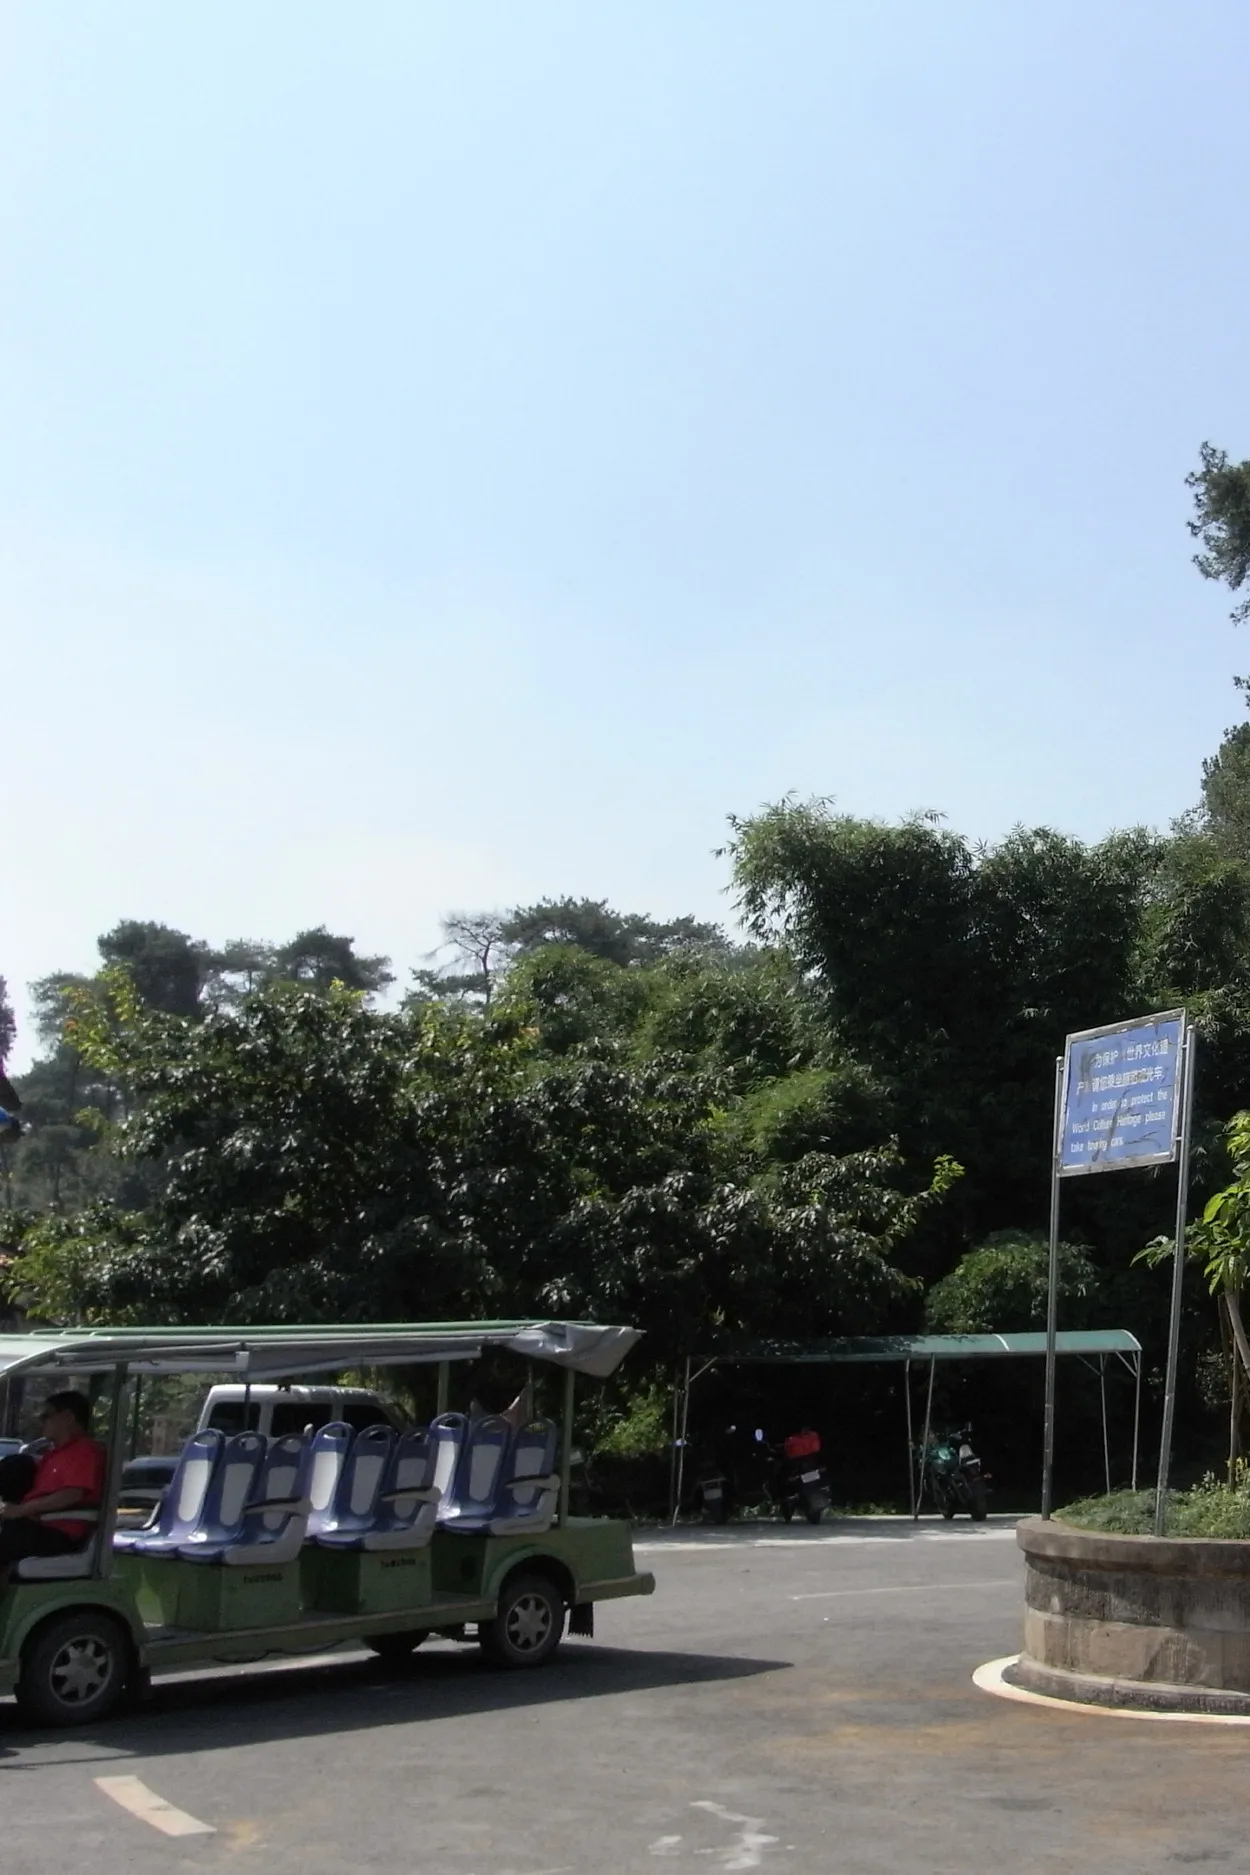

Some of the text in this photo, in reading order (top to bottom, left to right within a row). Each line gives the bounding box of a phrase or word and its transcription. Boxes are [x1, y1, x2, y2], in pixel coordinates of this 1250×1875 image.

[1131, 1091, 1153, 1107] protect
[1157, 1089, 1168, 1100] the
[1145, 1111, 1166, 1125] please
[1070, 1141, 1084, 1153] take
